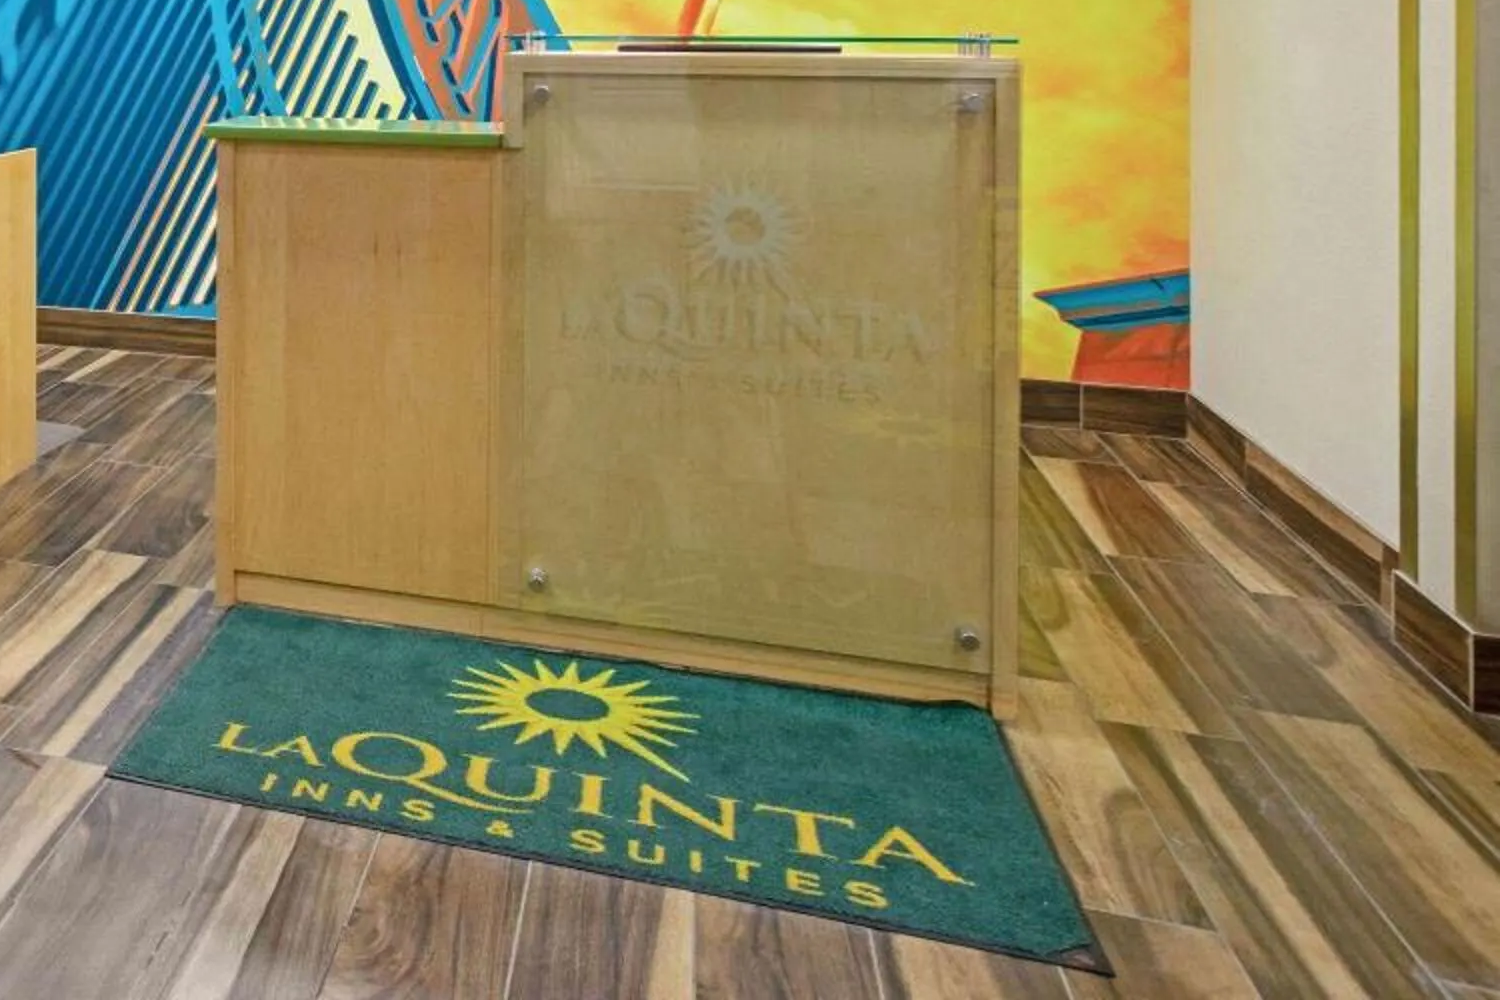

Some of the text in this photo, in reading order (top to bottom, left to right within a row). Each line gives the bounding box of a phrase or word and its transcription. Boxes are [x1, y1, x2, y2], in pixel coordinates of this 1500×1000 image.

[259, 773, 891, 908] INNS & SUITES
